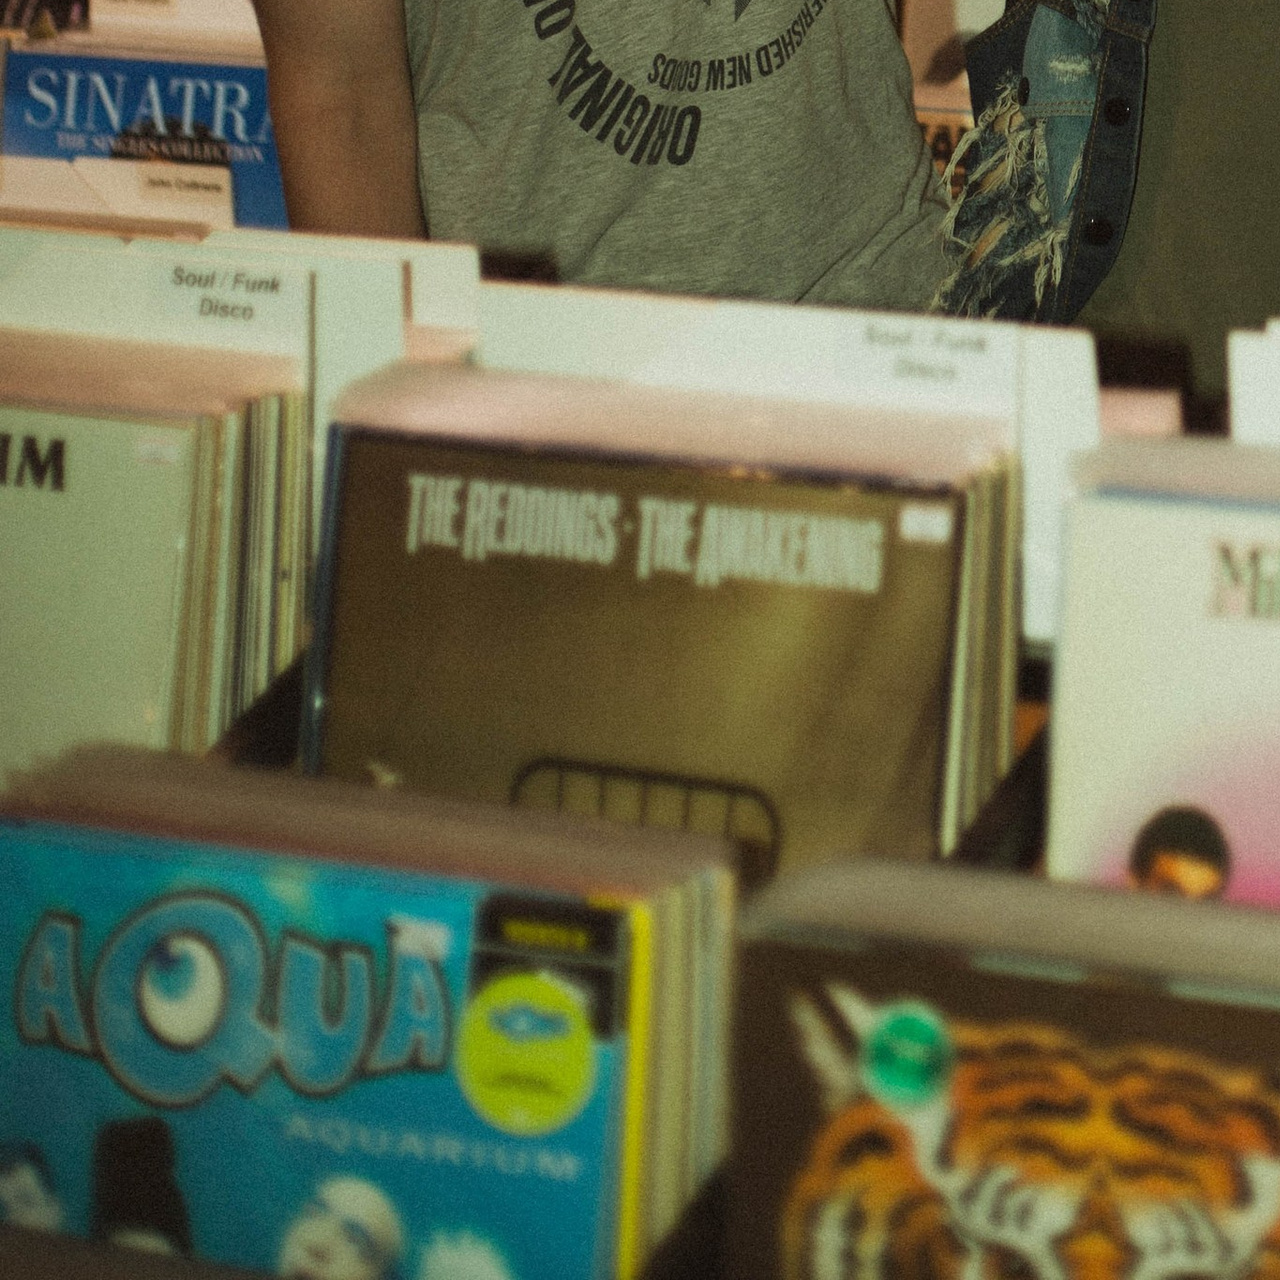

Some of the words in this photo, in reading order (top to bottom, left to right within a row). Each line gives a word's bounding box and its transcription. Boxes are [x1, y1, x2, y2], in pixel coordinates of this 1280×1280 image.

[647, 53, 702, 92] GOODS
[706, 52, 752, 91] NEW
[547, 24, 702, 166] ORIGINAL
[172, 266, 215, 290] Soul
[232, 273, 281, 294] Funk
[199, 296, 254, 321] Disco
[407, 473, 463, 554] THE
[637, 496, 697, 580] THE
[13, 888, 455, 1110] AQUA
